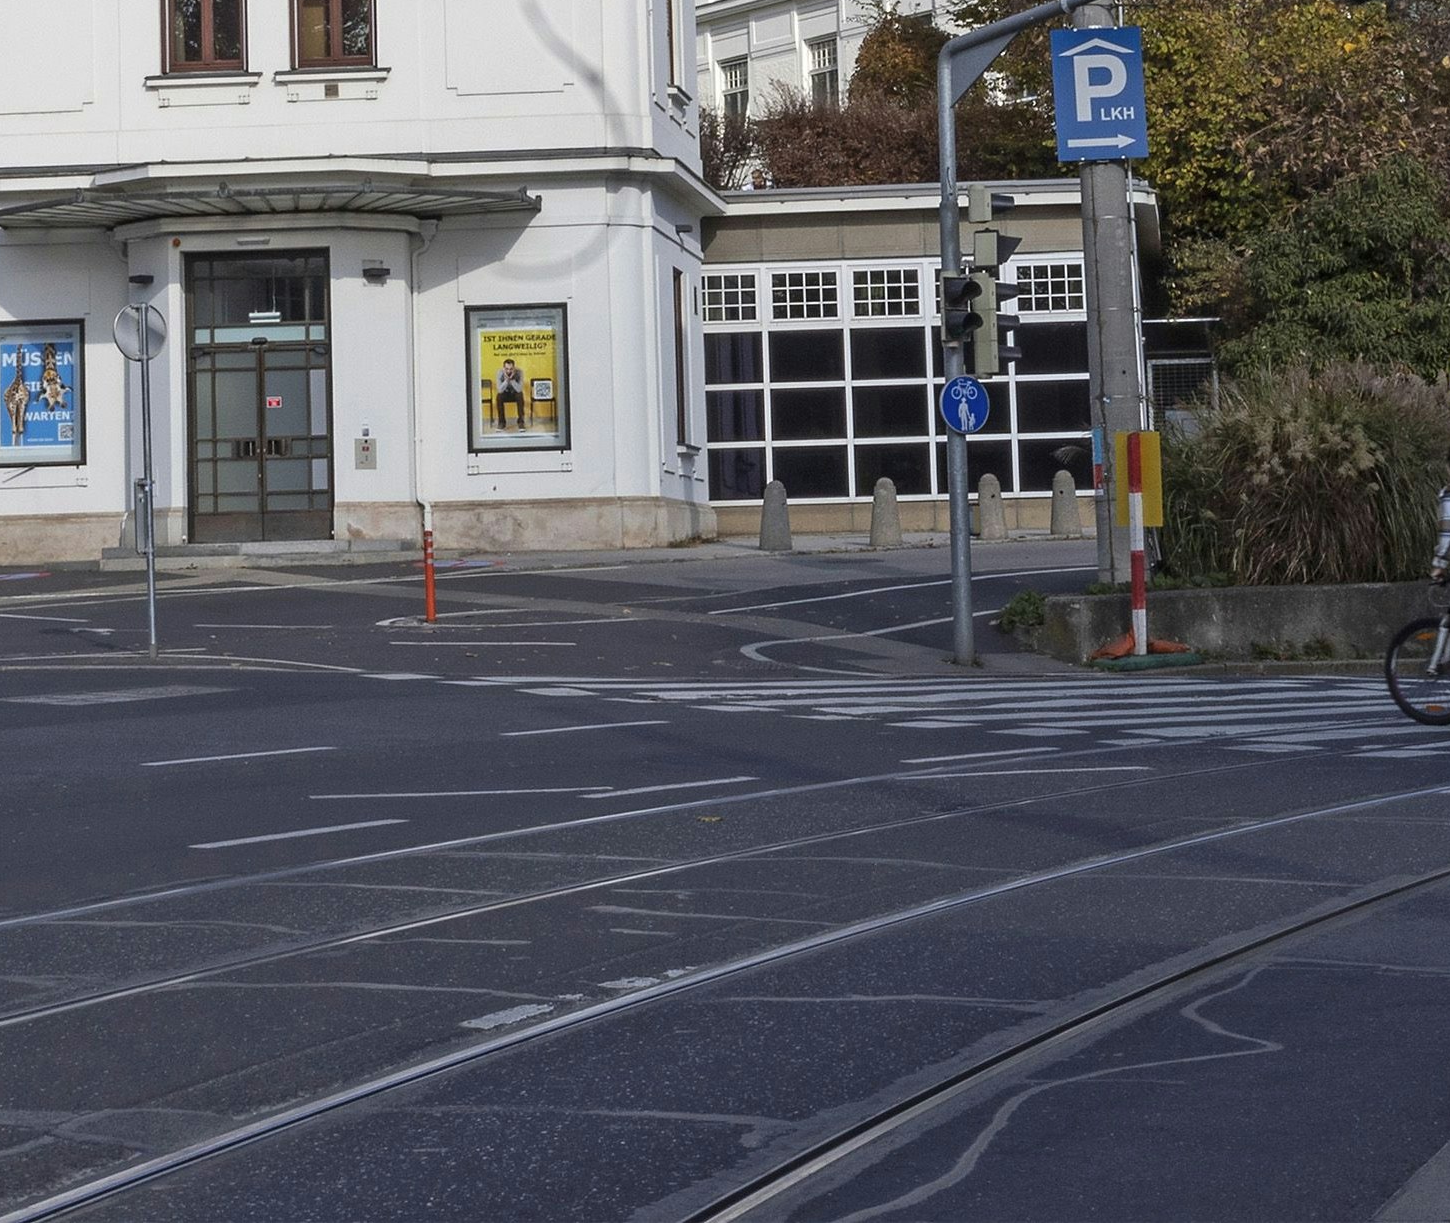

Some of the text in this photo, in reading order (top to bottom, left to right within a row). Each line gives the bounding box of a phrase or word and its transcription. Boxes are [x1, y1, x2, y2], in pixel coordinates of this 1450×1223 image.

[1073, 54, 1127, 122] P
[1100, 106, 1135, 121] LKH
[483, 335, 496, 343] IST
[498, 334, 524, 342] IHNEN
[2, 348, 73, 367] MÜSEN
